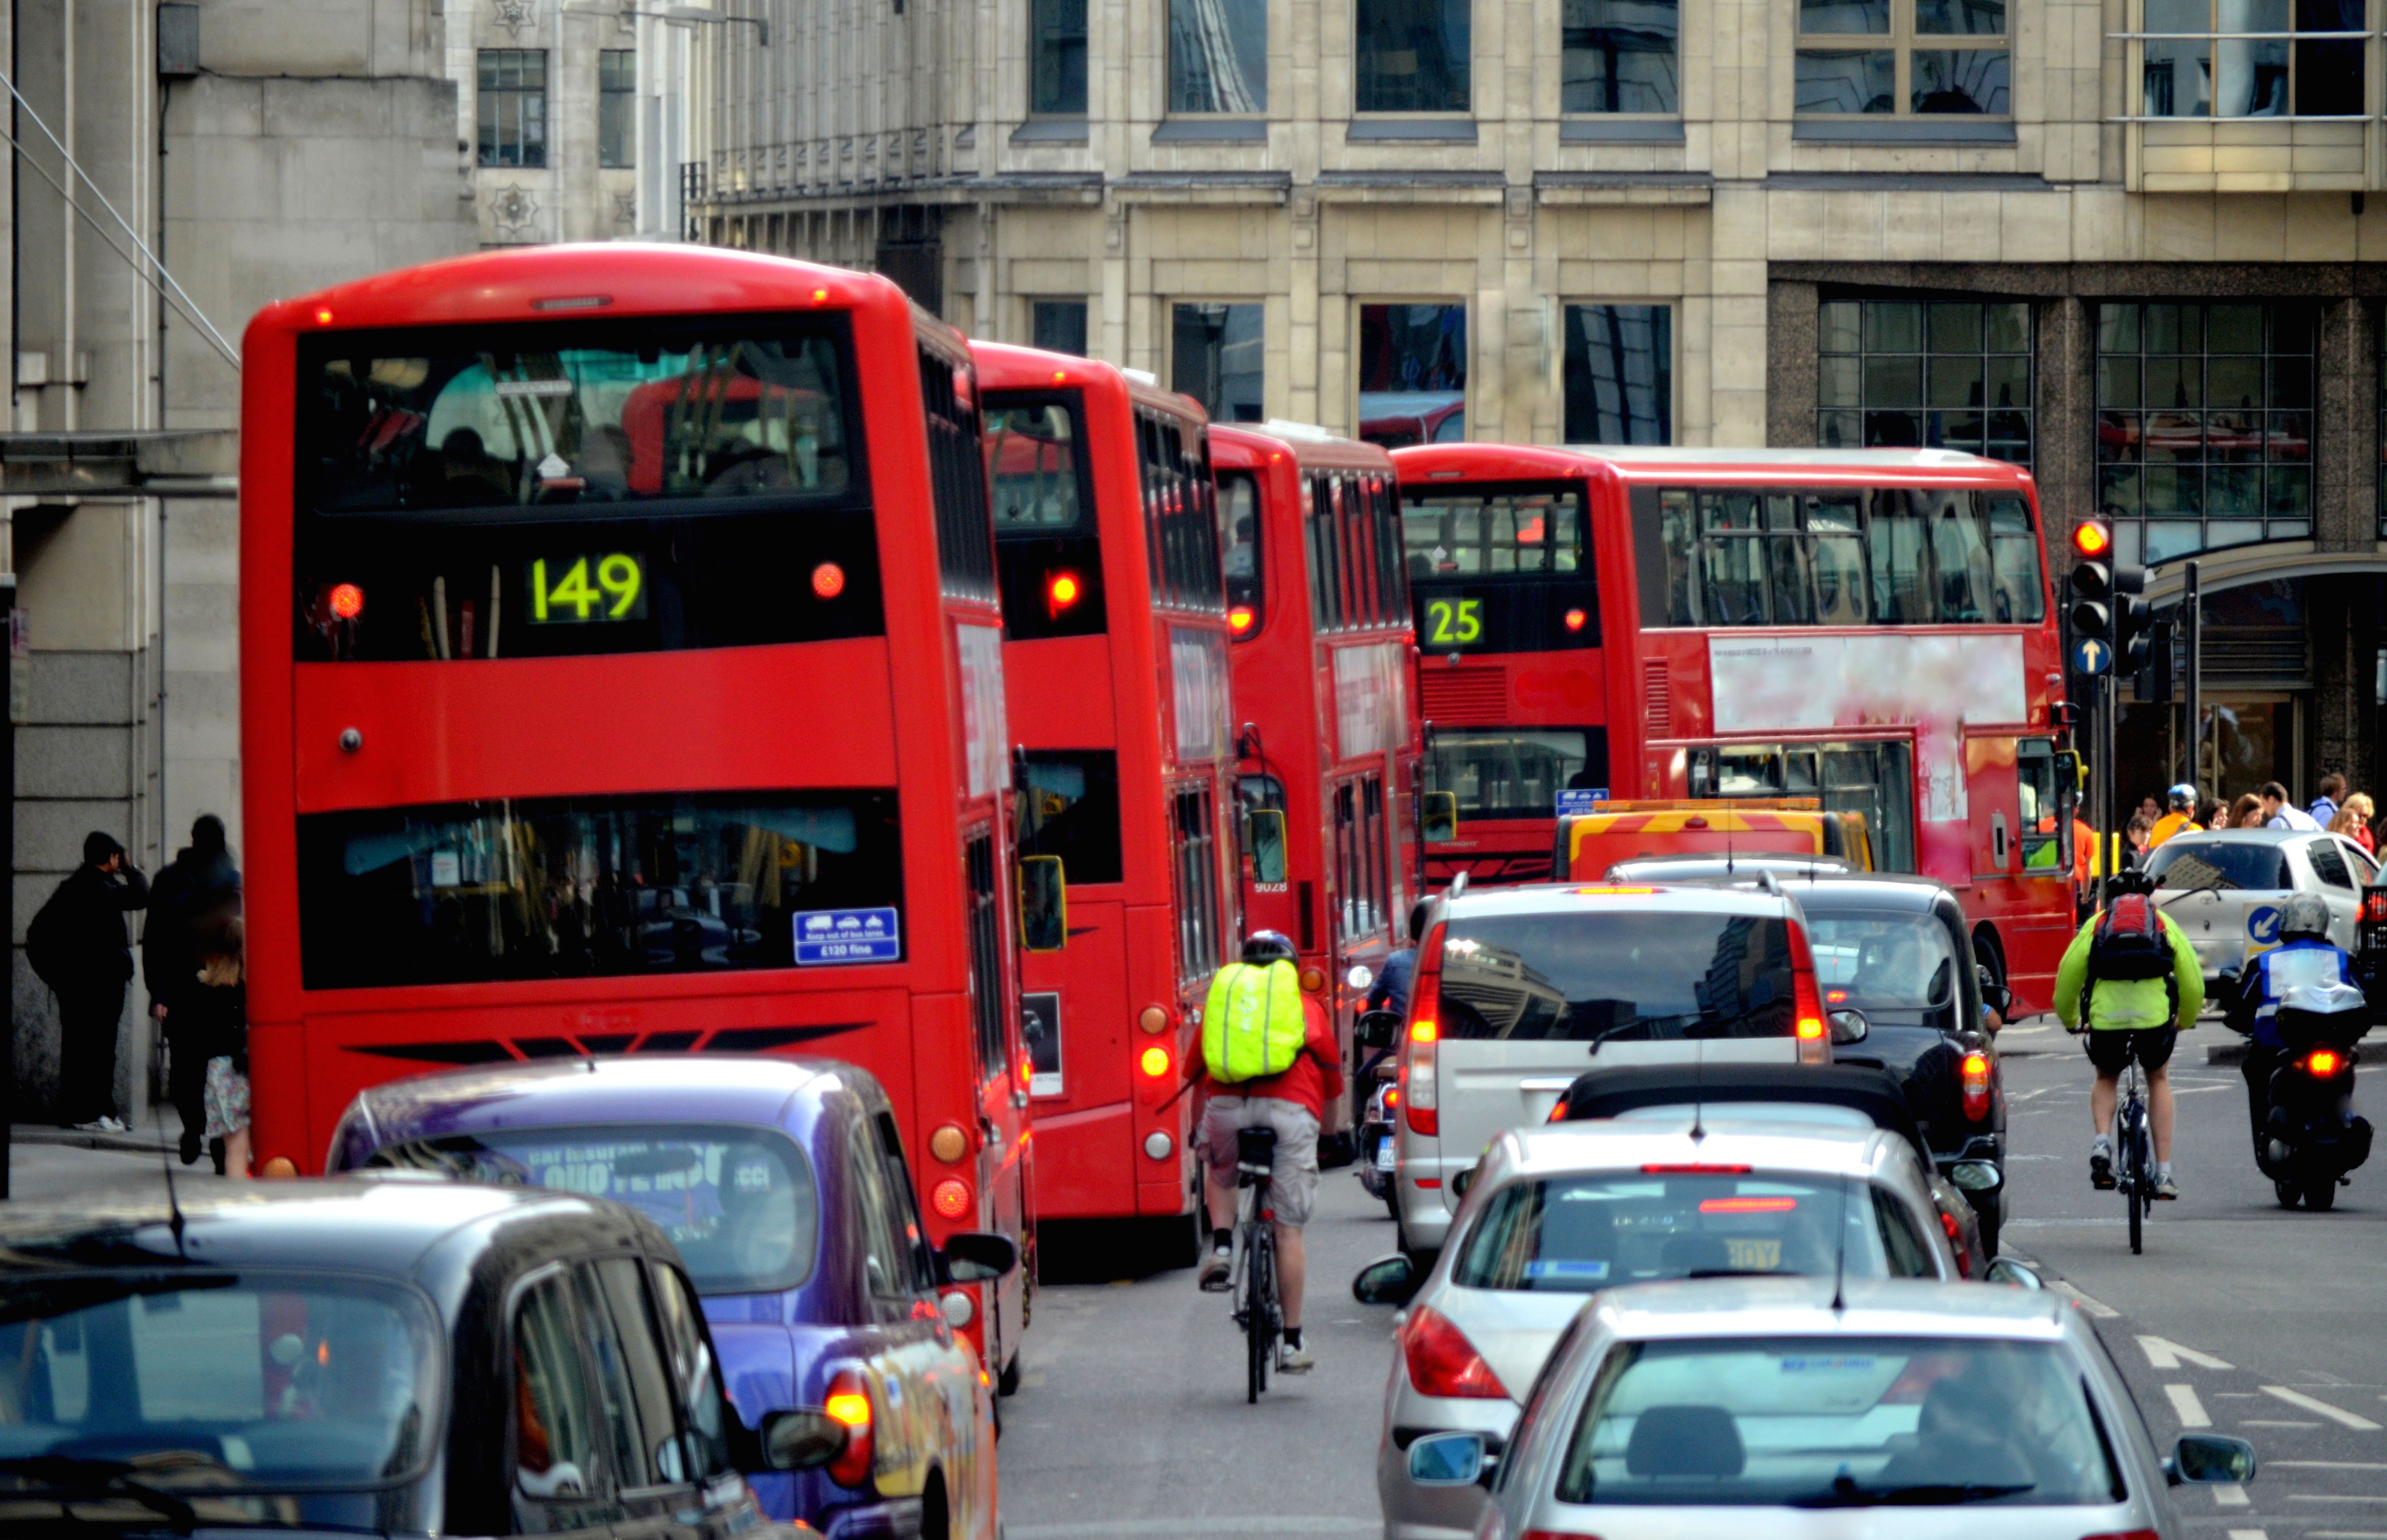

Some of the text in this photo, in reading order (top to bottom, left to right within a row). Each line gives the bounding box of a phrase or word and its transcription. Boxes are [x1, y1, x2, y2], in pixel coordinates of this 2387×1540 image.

[533, 553, 640, 621] 149
[1429, 600, 1480, 642] 25
[1255, 882, 1287, 892] 9028
[821, 944, 872, 957] £120 fine
